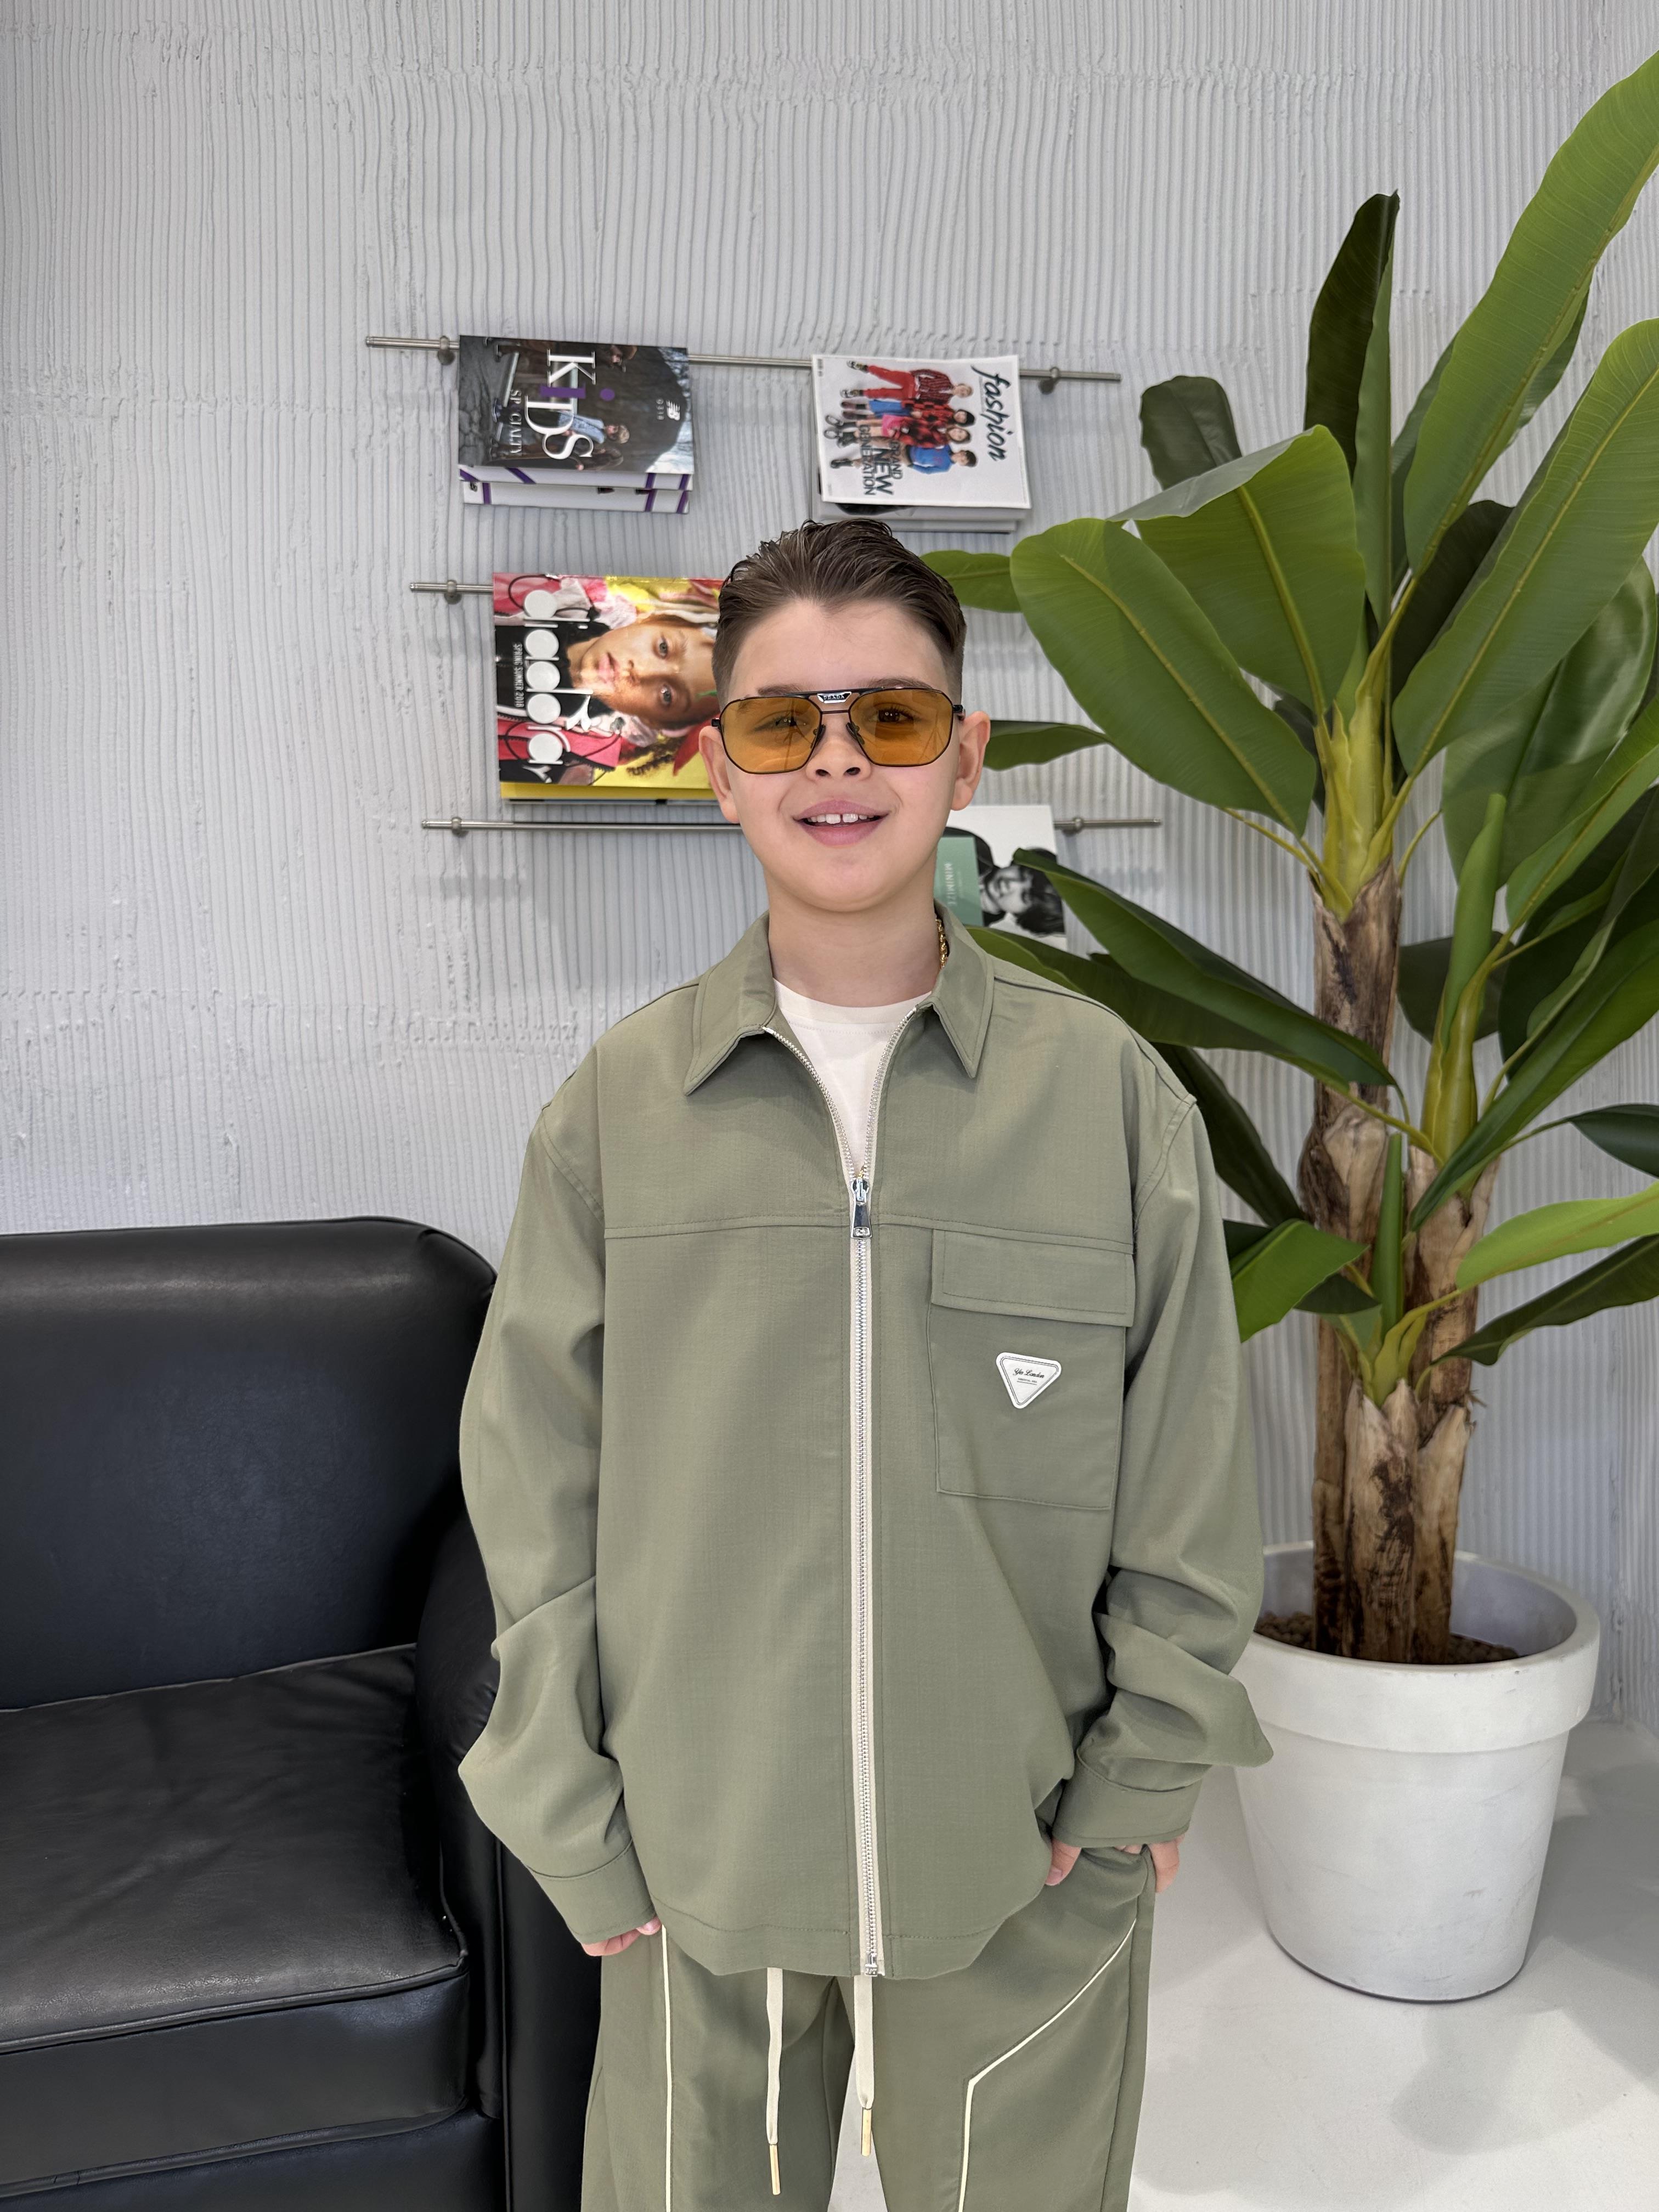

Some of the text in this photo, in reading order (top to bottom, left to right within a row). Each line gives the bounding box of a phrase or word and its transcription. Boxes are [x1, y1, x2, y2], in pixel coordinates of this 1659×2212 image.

[509, 389, 522, 456] SPCIALTY
[971, 364, 1014, 461] fashion
[859, 424, 876, 495] GENERATION
[873, 447, 894, 495] NEW
[889, 441, 904, 480] BRAND
[512, 643, 523, 665] SPRING
[514, 667, 524, 691] SUMMER
[523, 590, 594, 765] diadora
